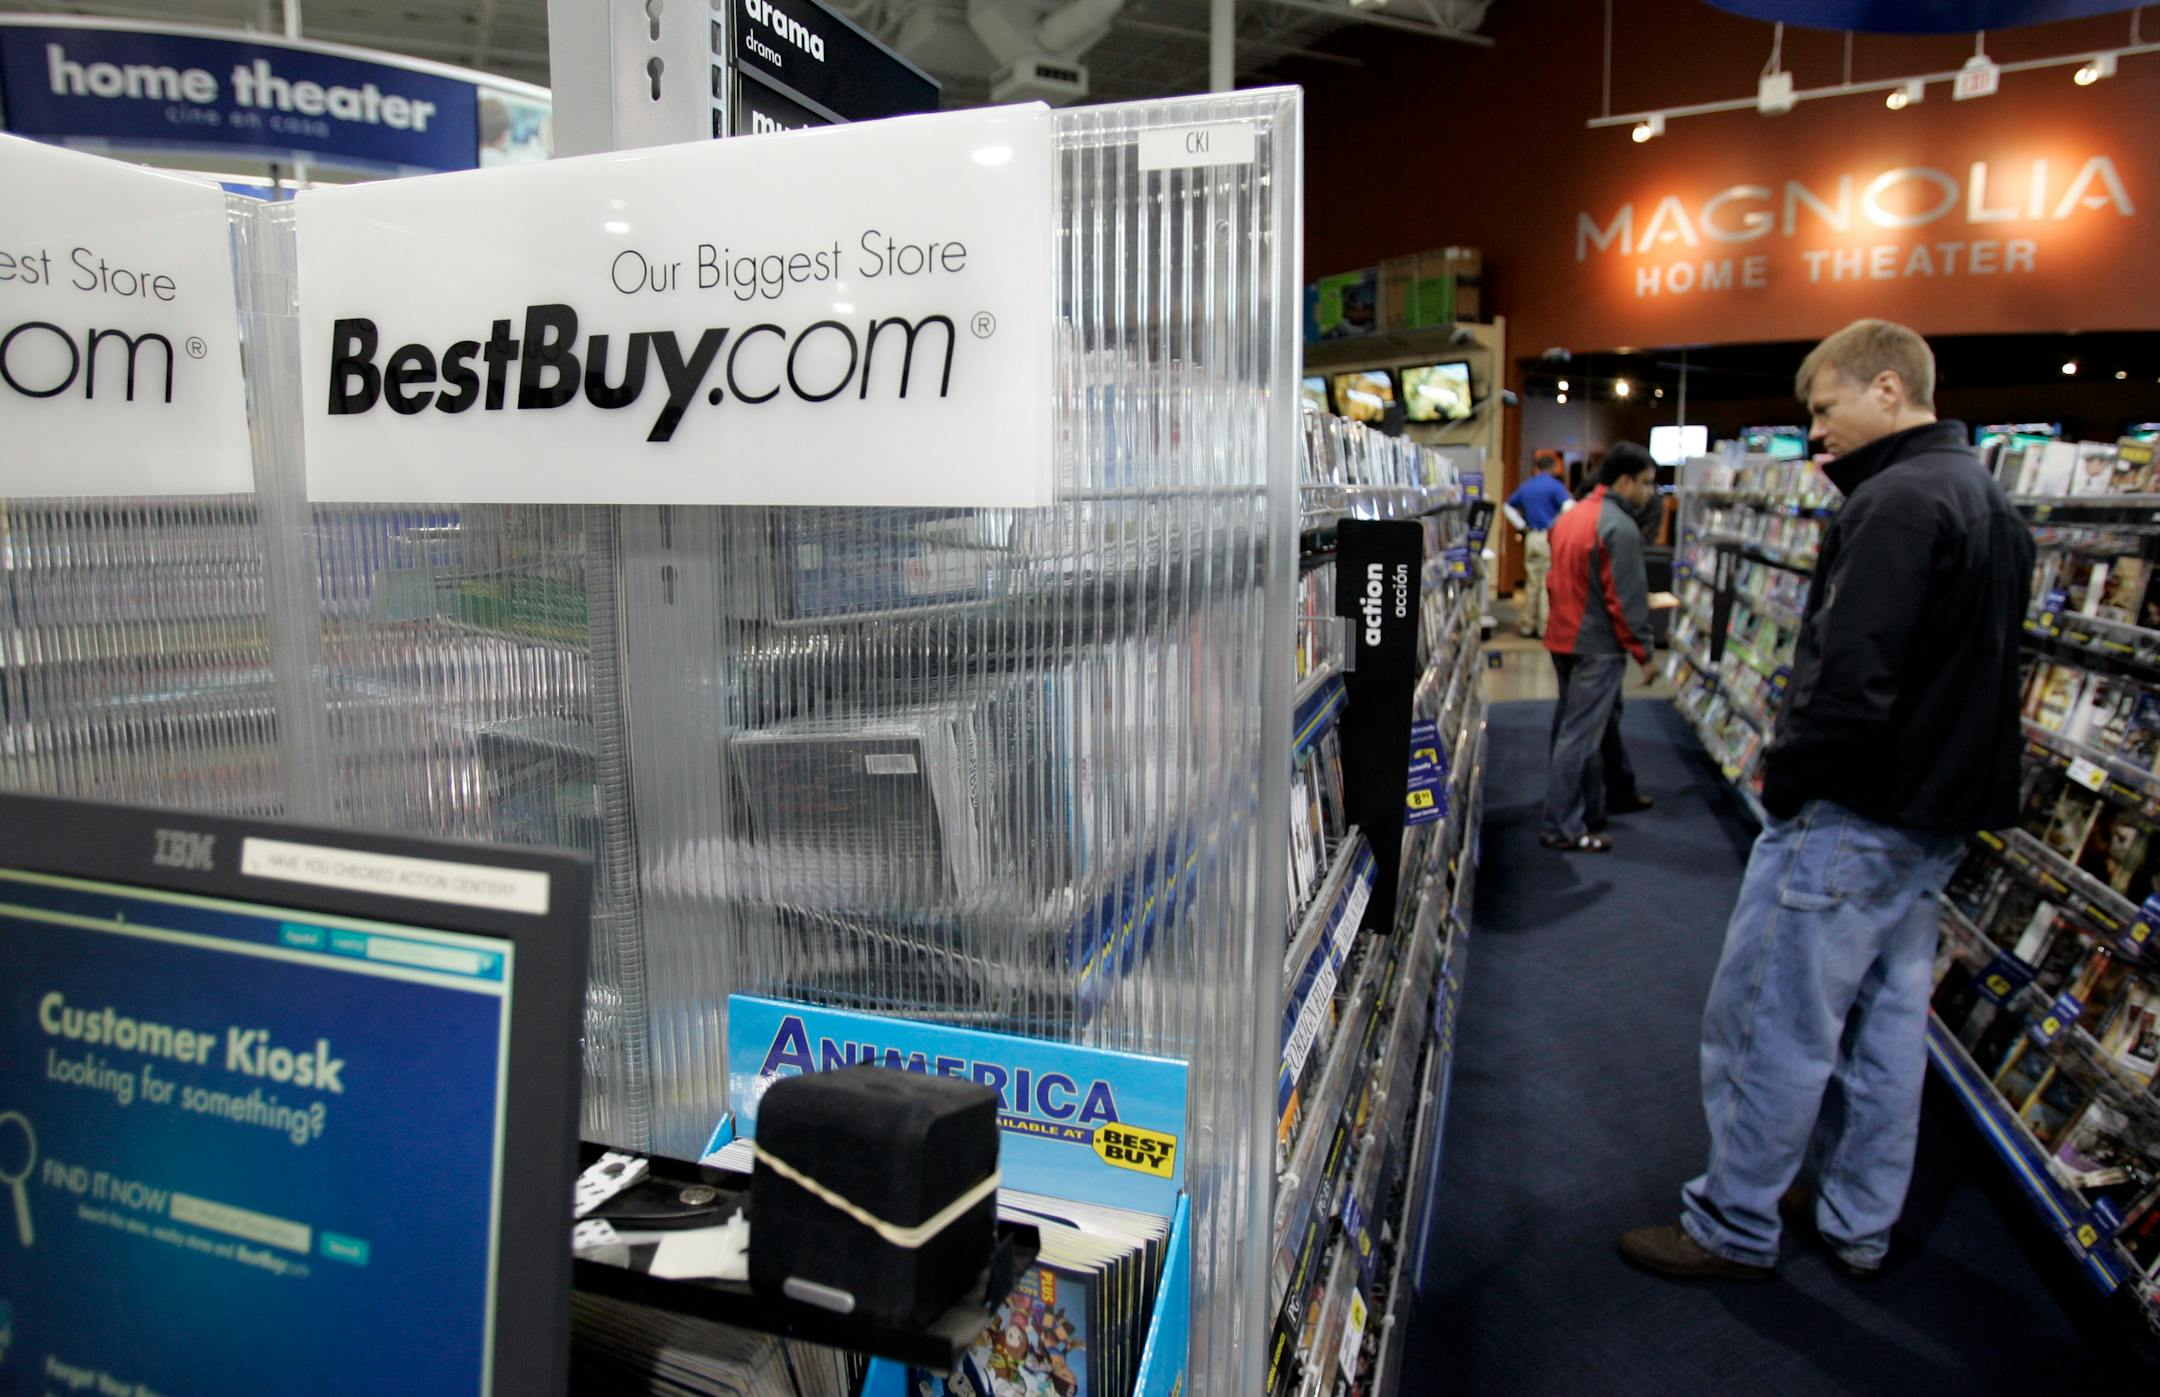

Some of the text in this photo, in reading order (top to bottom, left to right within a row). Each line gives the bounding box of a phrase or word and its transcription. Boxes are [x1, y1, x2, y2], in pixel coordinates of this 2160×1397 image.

[745, 28, 782, 67] drama
[46, 44, 436, 132] home theater
[165, 103, 332, 139] cine en casa
[1185, 130, 1209, 153] CKI
[1575, 155, 2136, 262] MAGNOLIA
[71, 247, 176, 302] Store
[611, 229, 967, 301] Our Biggest Store
[1635, 239, 2037, 299] HOME THEATER
[327, 303, 955, 442] BestBuy.com
[1360, 563, 1384, 647] action
[1392, 564, 1408, 618] acción
[152, 828, 216, 871] IBM
[266, 853, 301, 872] HAVE
[304, 857, 330, 875] YOU
[332, 860, 394, 885] CHECKED
[397, 869, 449, 891] ACTION
[39, 991, 346, 1094] Customer Kiosk
[48, 1047, 327, 1146] Looking for something?
[1063, 1128, 1085, 1140] AT
[1102, 1129, 1174, 1157] BEST
[1104, 1144, 1167, 1170] BUY
[43, 1158, 170, 1215] FIND IT NOW
[1041, 1270, 1055, 1304] PLUS
[1287, 1296, 1300, 1324] PG
